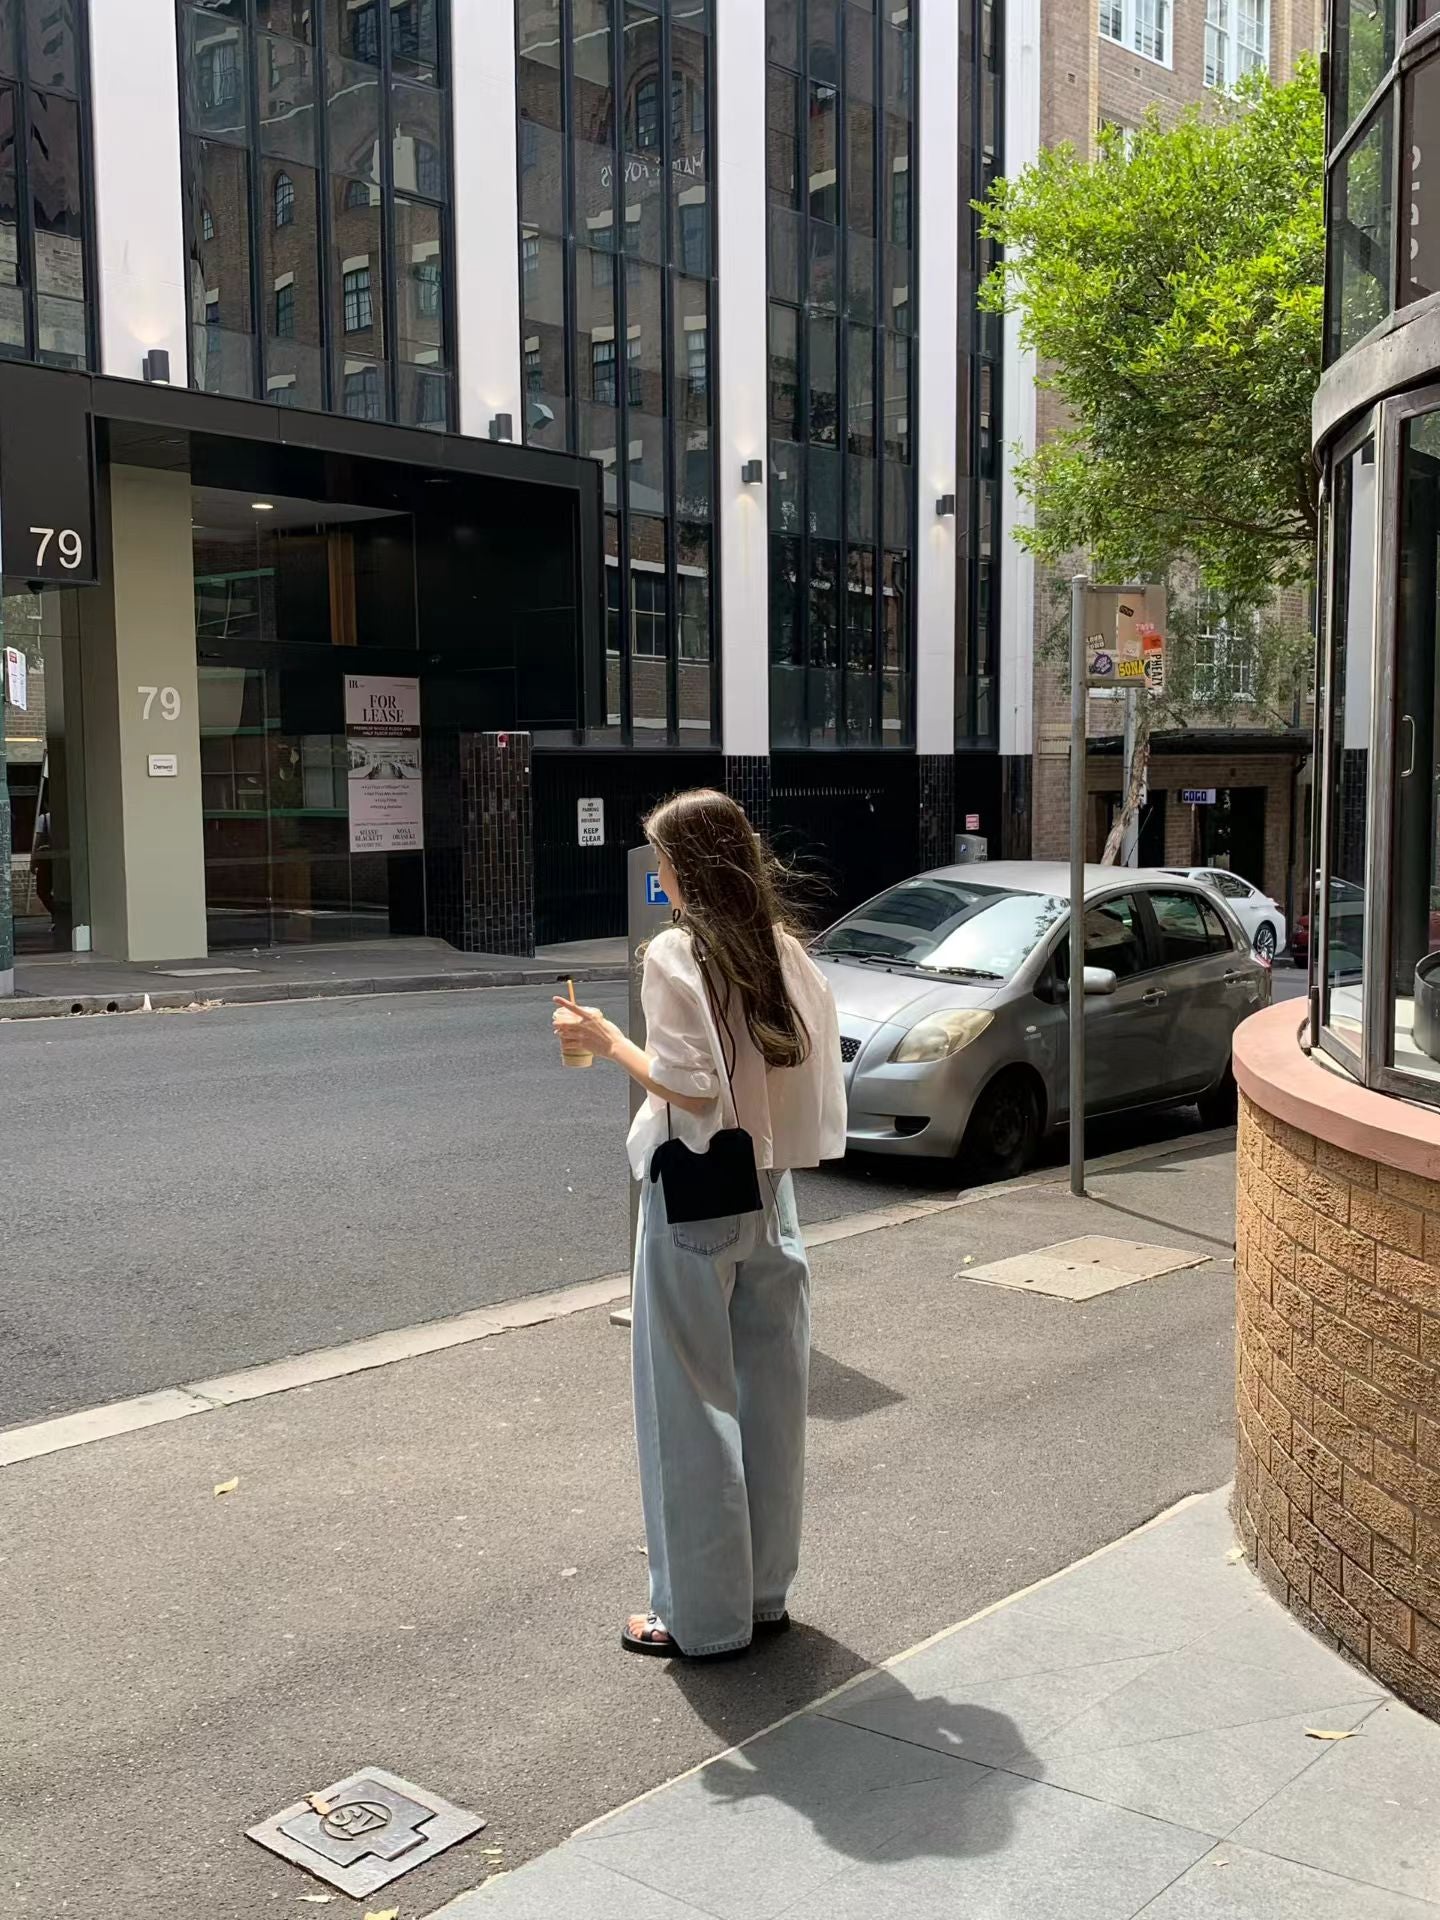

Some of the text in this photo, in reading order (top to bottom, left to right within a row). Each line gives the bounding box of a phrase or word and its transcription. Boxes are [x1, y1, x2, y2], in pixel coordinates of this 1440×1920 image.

[30, 526, 82, 569] 79
[137, 686, 181, 721] 79
[369, 694, 397, 709] FOR
[362, 708, 405, 723] LEASE
[1183, 791, 1207, 801] GOGO
